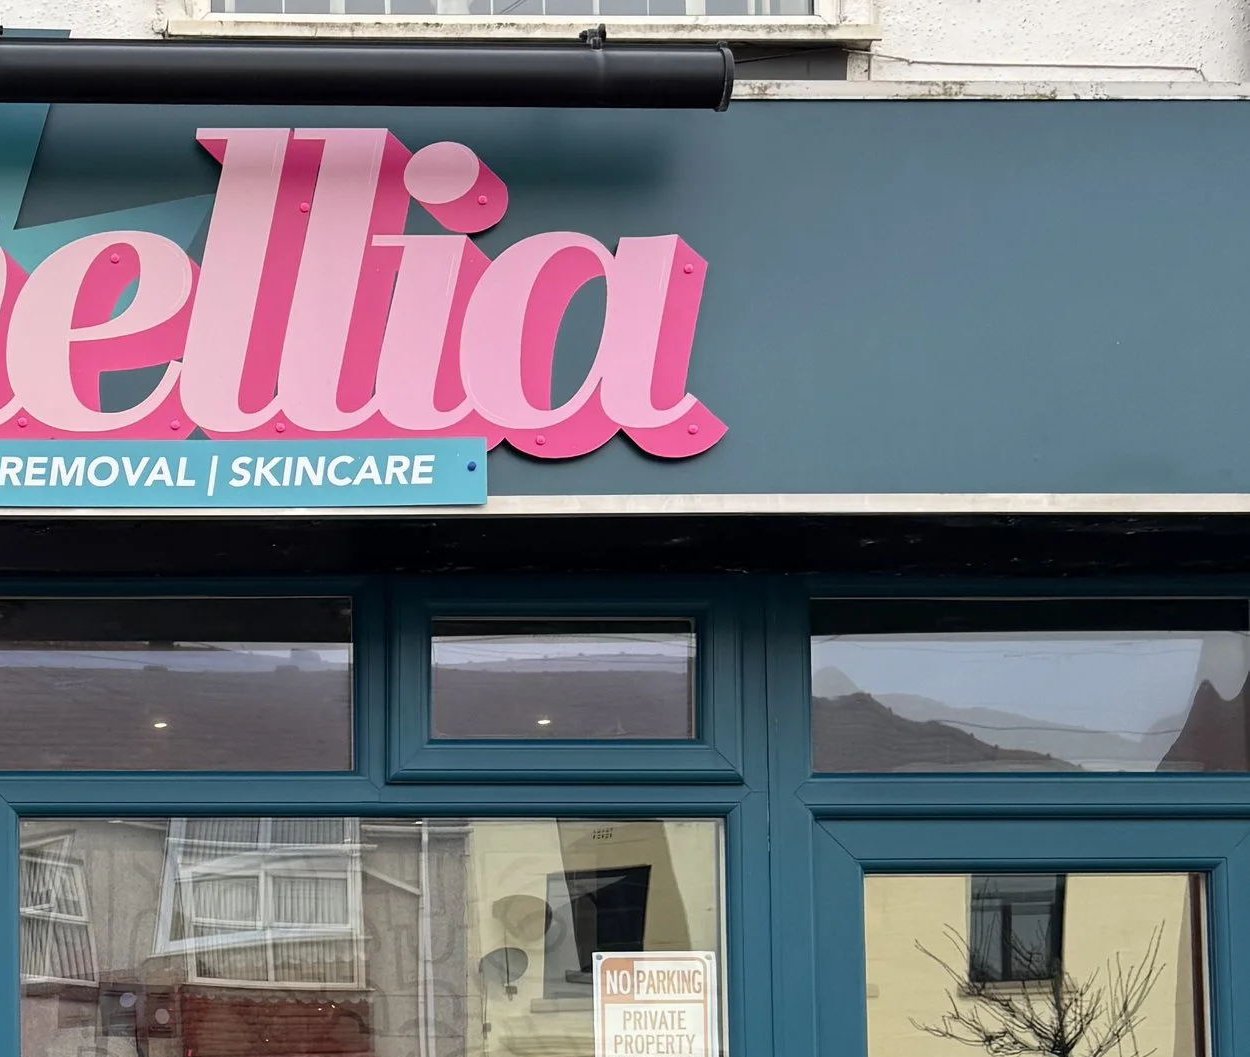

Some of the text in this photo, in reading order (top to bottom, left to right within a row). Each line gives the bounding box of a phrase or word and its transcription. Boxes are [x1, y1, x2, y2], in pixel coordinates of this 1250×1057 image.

[229, 455, 435, 486] SKINCARE
[605, 970, 702, 995] NO PARKING
[623, 1011, 686, 1030] PRIVATE
[614, 1034, 695, 1054] PROPERTY
